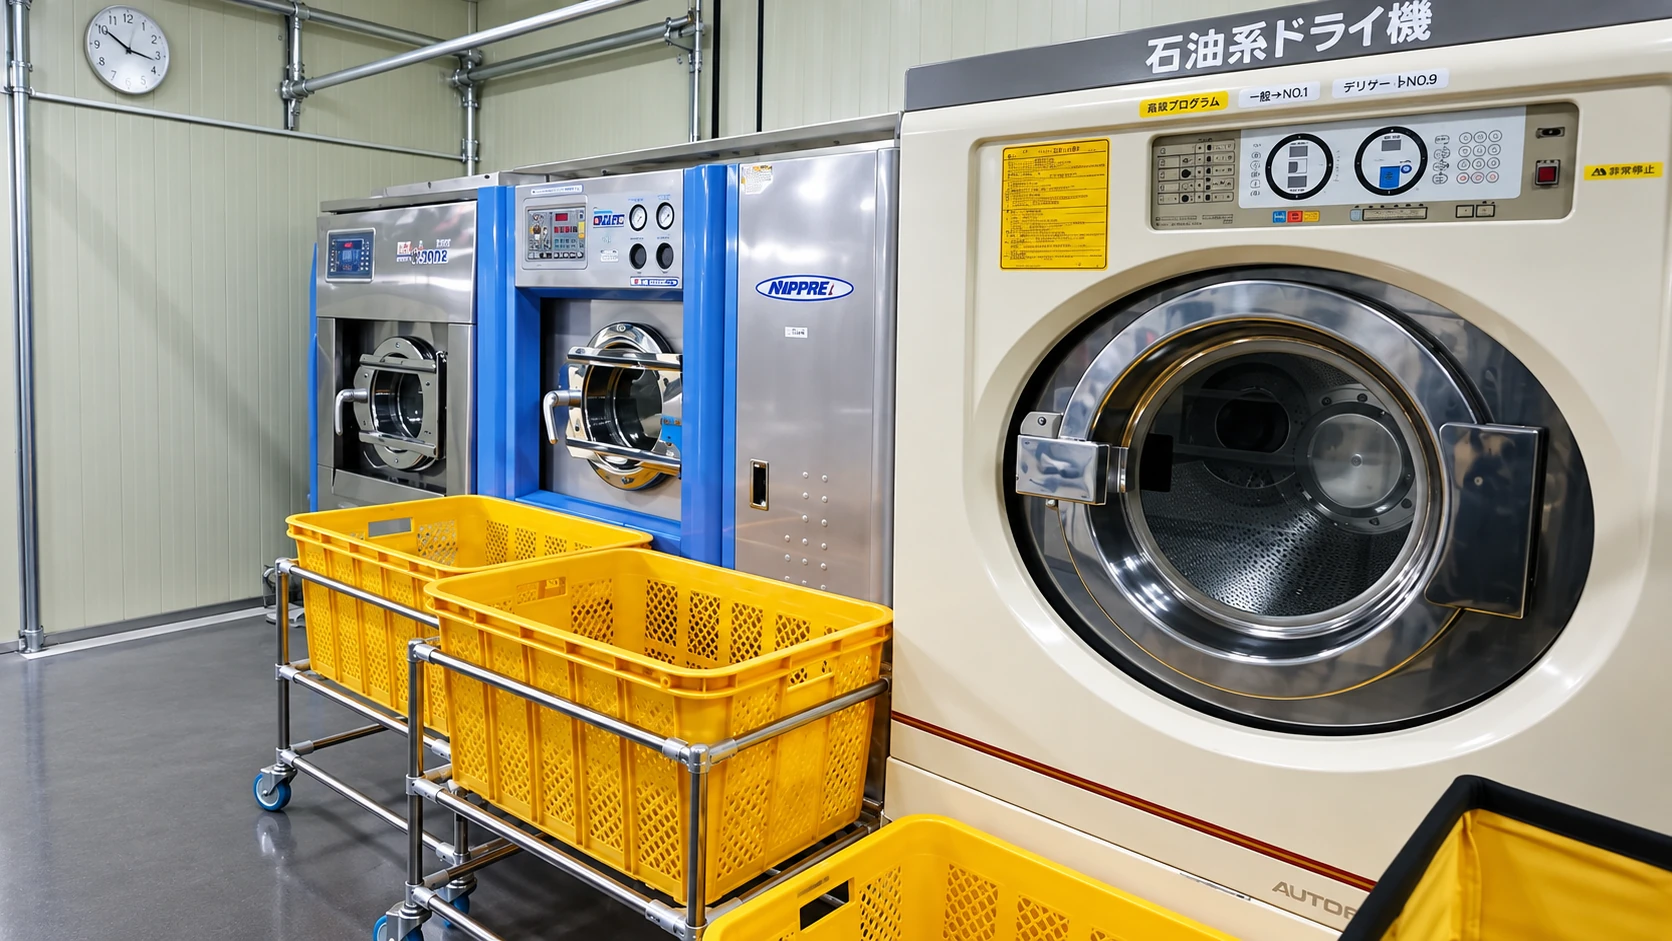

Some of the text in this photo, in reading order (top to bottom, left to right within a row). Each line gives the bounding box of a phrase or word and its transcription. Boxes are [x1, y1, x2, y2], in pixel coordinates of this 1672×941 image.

[108, 15, 117, 25] 11
[123, 13, 133, 24] 12
[98, 25, 108, 35] 10
[141, 22, 146, 31] 1
[151, 35, 157, 44] 2
[1145, 0, 1433, 74] 石油系ドライ機
[94, 40, 100, 49] 9
[155, 51, 161, 60] 3
[99, 57, 105, 66] 8
[111, 70, 117, 80] 7
[151, 66, 157, 75] 4
[125, 78, 131, 86] 6
[141, 76, 147, 85] 5
